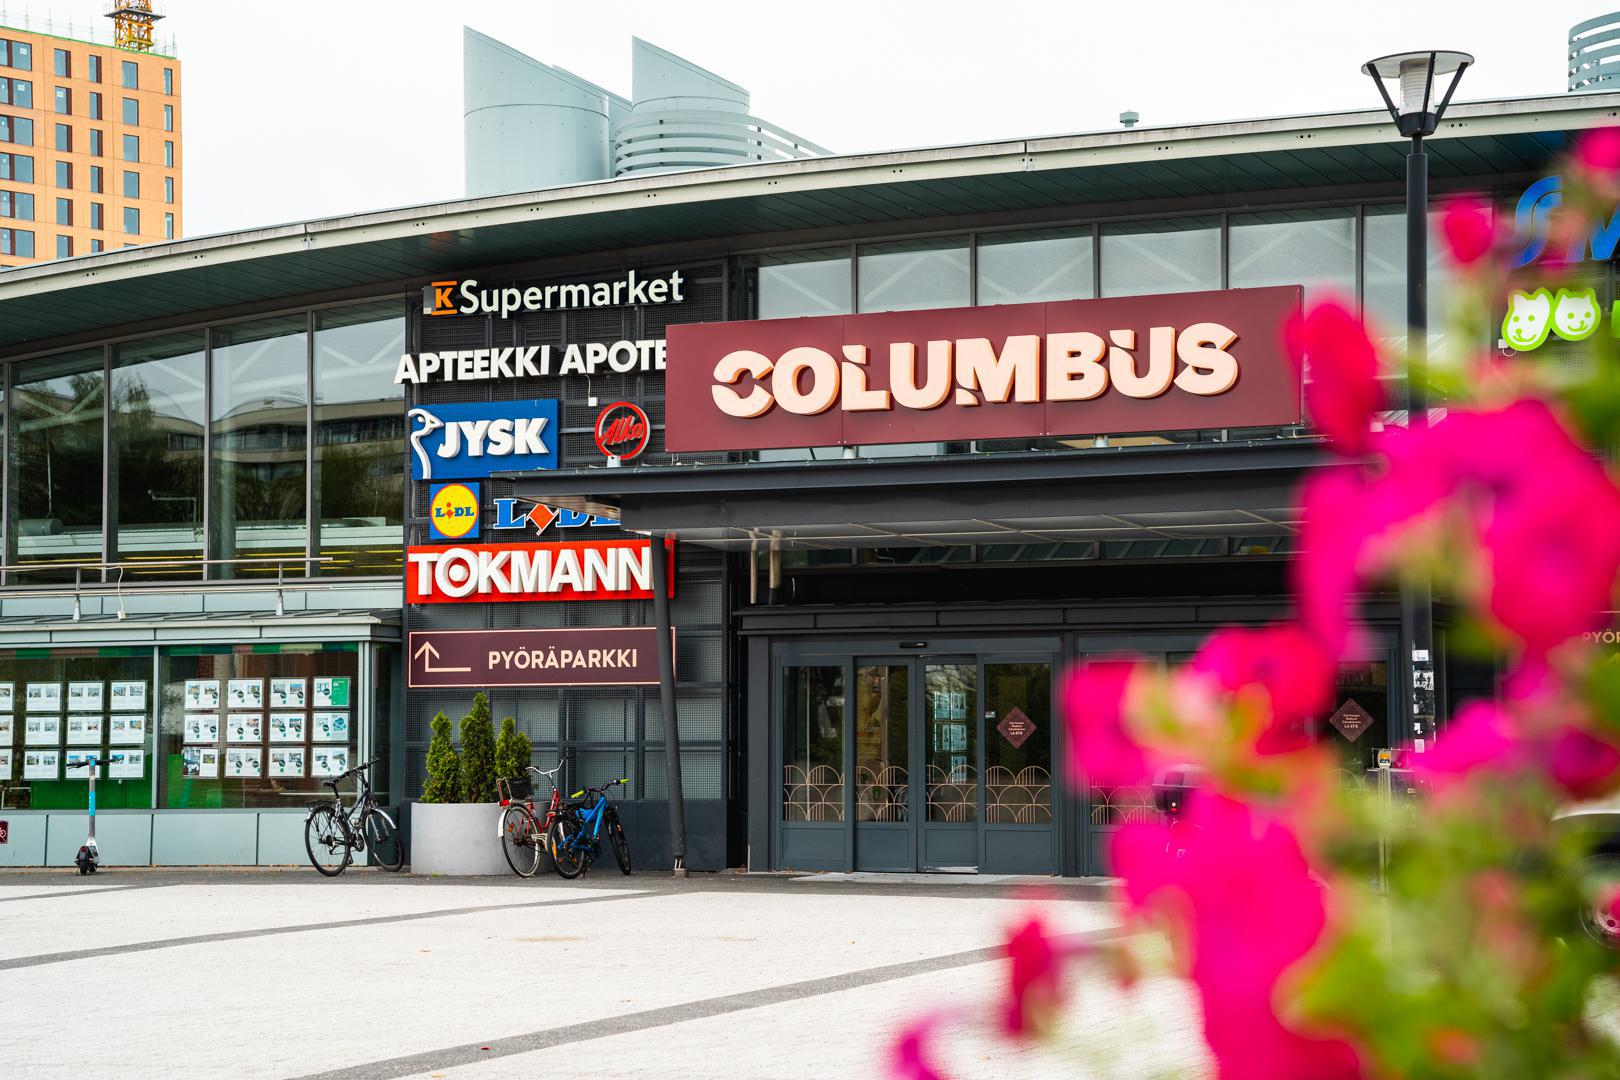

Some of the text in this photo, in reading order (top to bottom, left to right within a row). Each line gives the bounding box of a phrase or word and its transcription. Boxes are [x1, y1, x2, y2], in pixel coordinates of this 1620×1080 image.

[432, 270, 684, 319] K Supermarket
[394, 345, 551, 384] APTEEKKI
[711, 321, 1239, 419] COLUMBUS
[437, 418, 550, 458] JYSK
[600, 414, 643, 445] Alko
[408, 546, 654, 598] TOKMANN
[488, 646, 638, 669] PYÖRÄPARKKI
